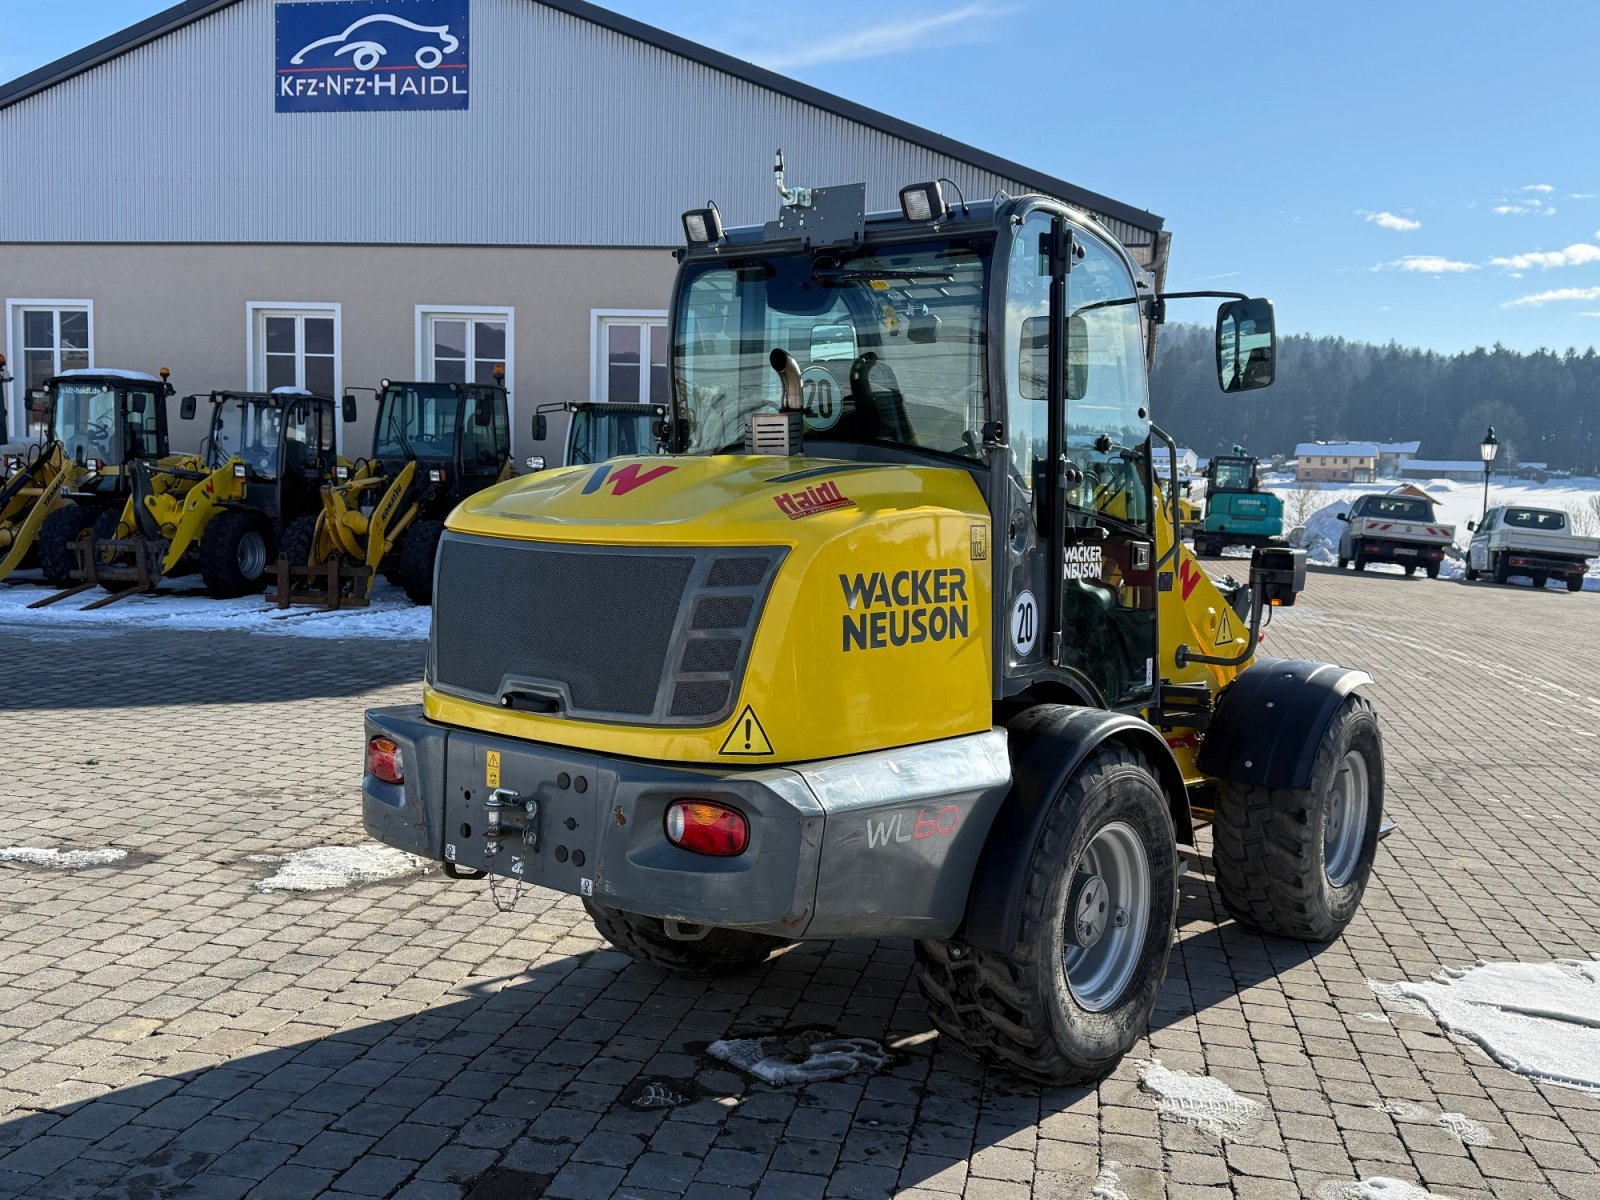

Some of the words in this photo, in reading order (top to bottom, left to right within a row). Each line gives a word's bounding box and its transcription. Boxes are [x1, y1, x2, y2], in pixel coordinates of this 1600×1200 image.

[803, 378, 833, 419] 20
[1063, 546, 1102, 562] WACKER
[1063, 562, 1102, 579] NEUSON
[839, 568, 968, 610] WACKER
[842, 604, 968, 652] NEUSON
[1017, 602, 1032, 644] 20
